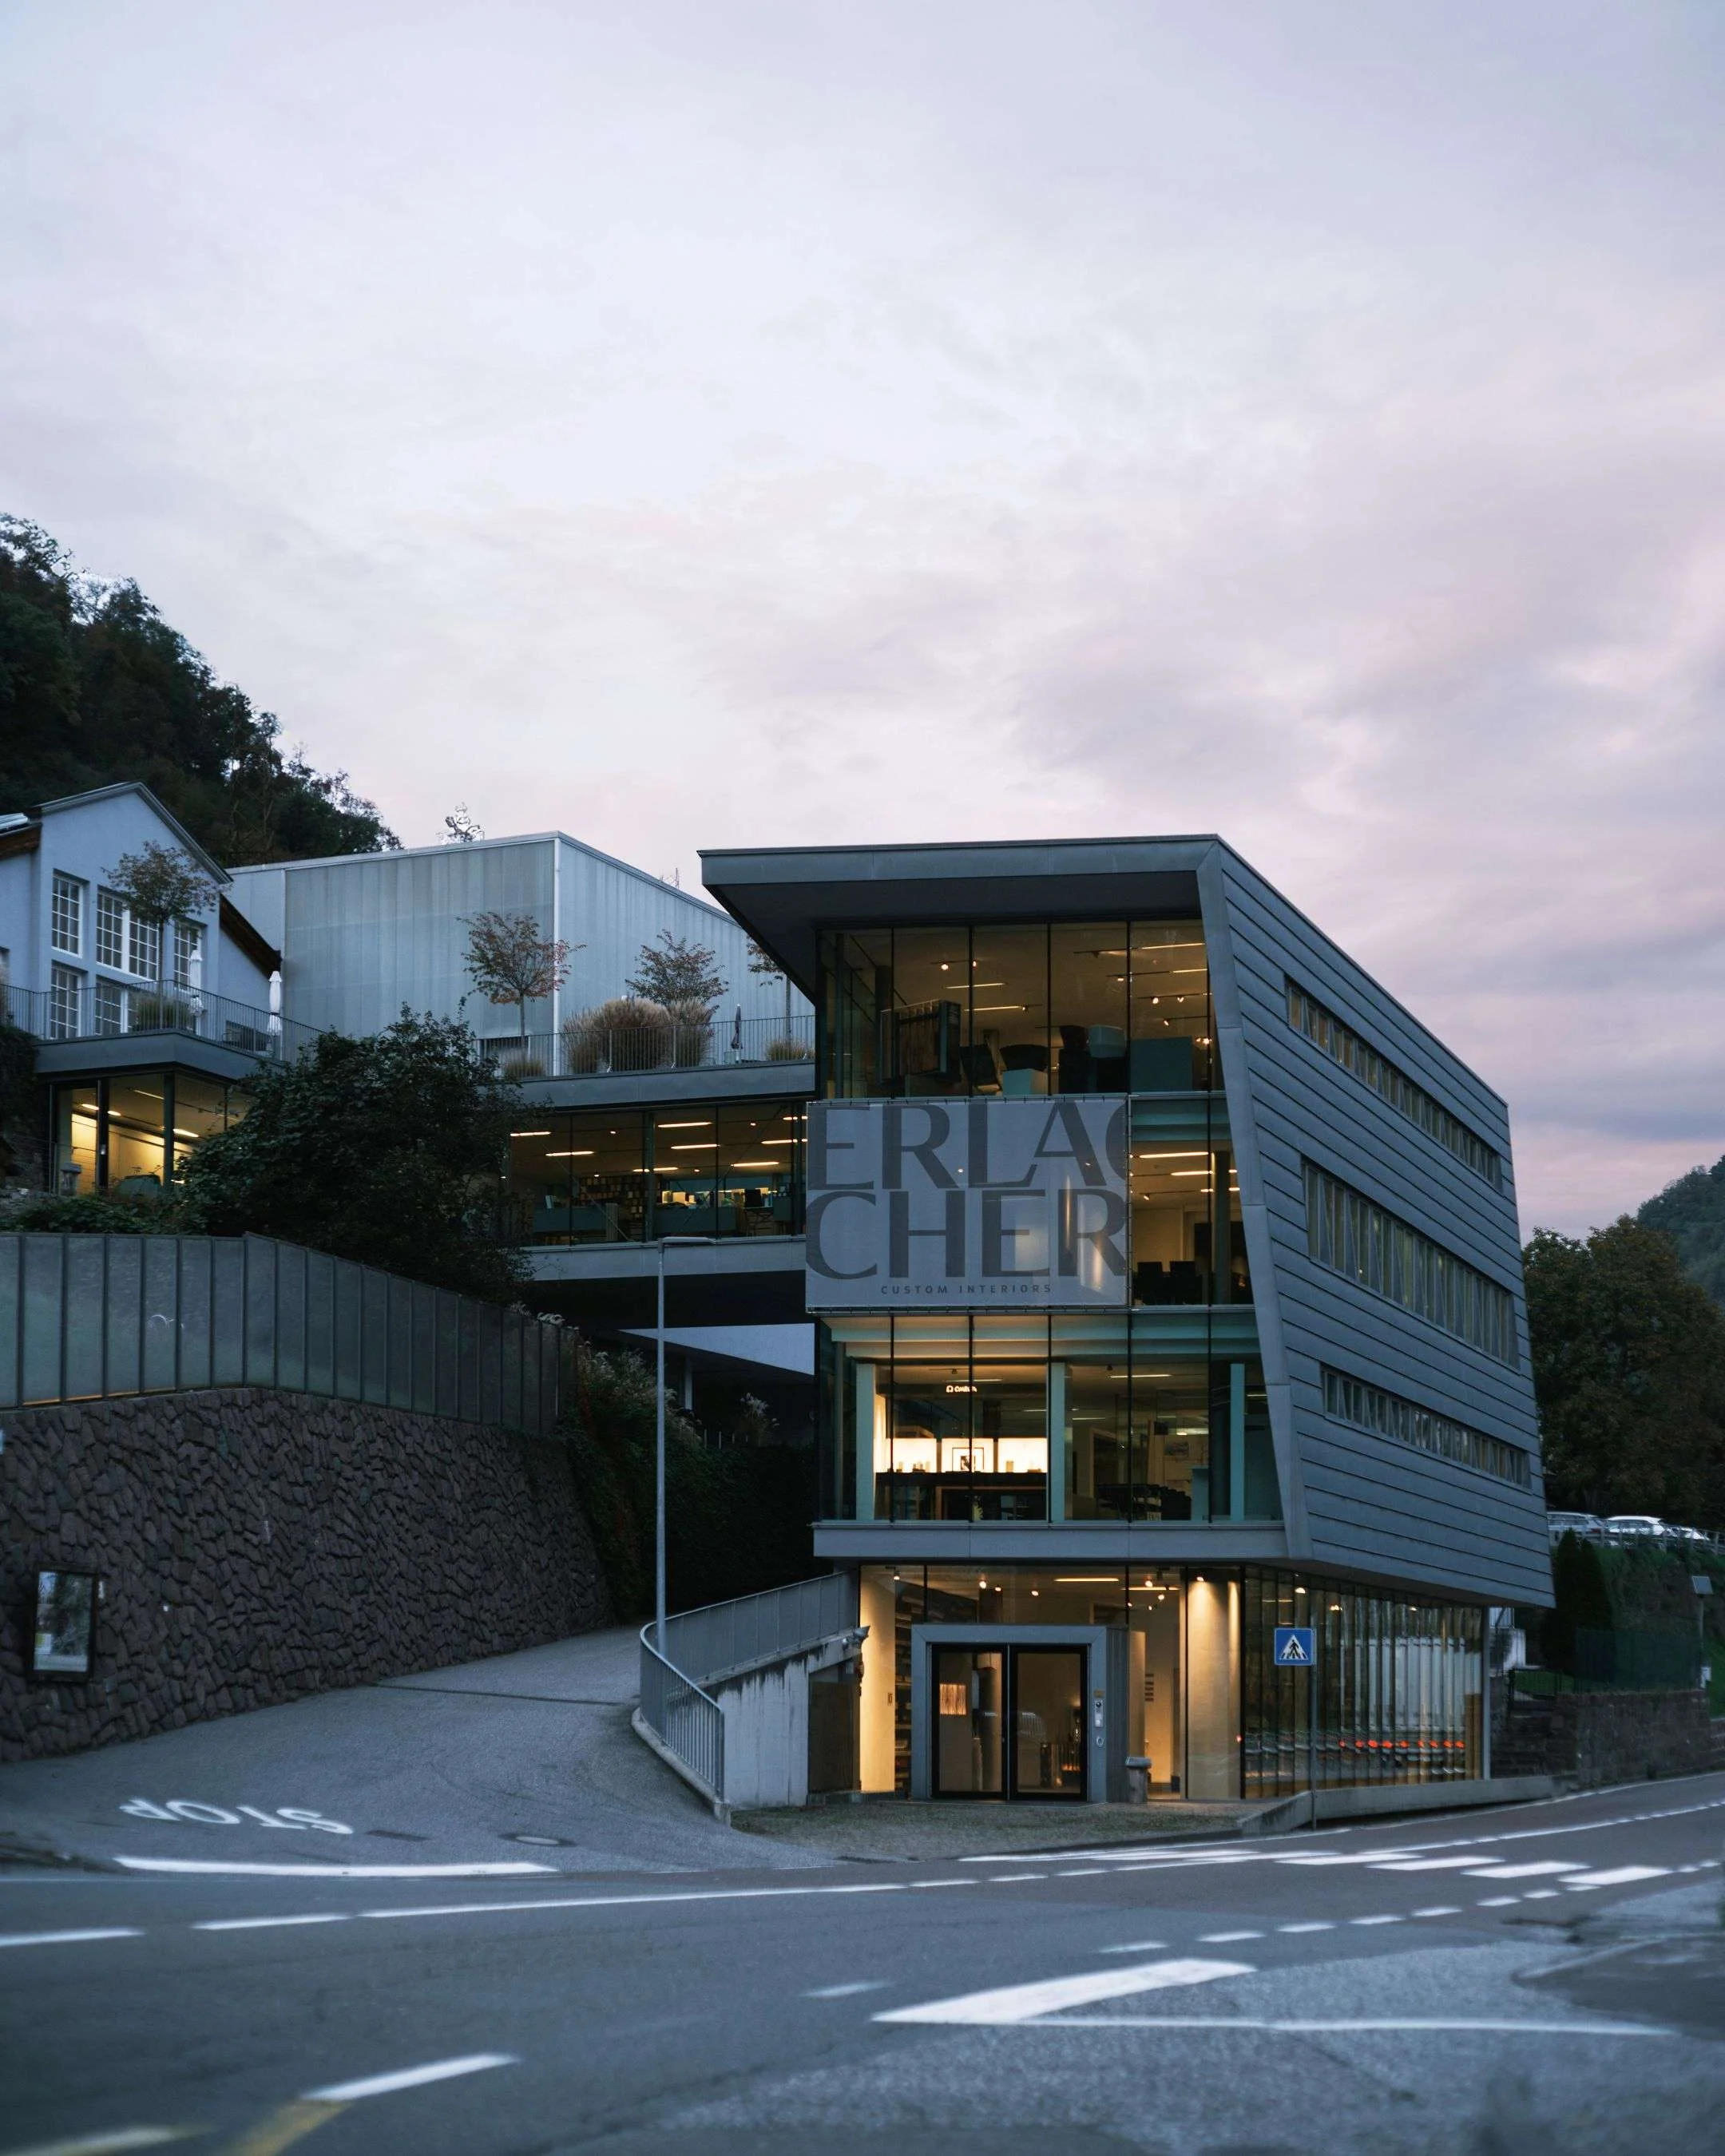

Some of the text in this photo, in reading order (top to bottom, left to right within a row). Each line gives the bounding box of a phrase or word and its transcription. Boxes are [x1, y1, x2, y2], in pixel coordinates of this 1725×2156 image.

[806, 1188, 1126, 1279] CHER
[880, 1284, 1051, 1294] CUSTOM INTERIORS
[119, 1795, 355, 1835] STOP
